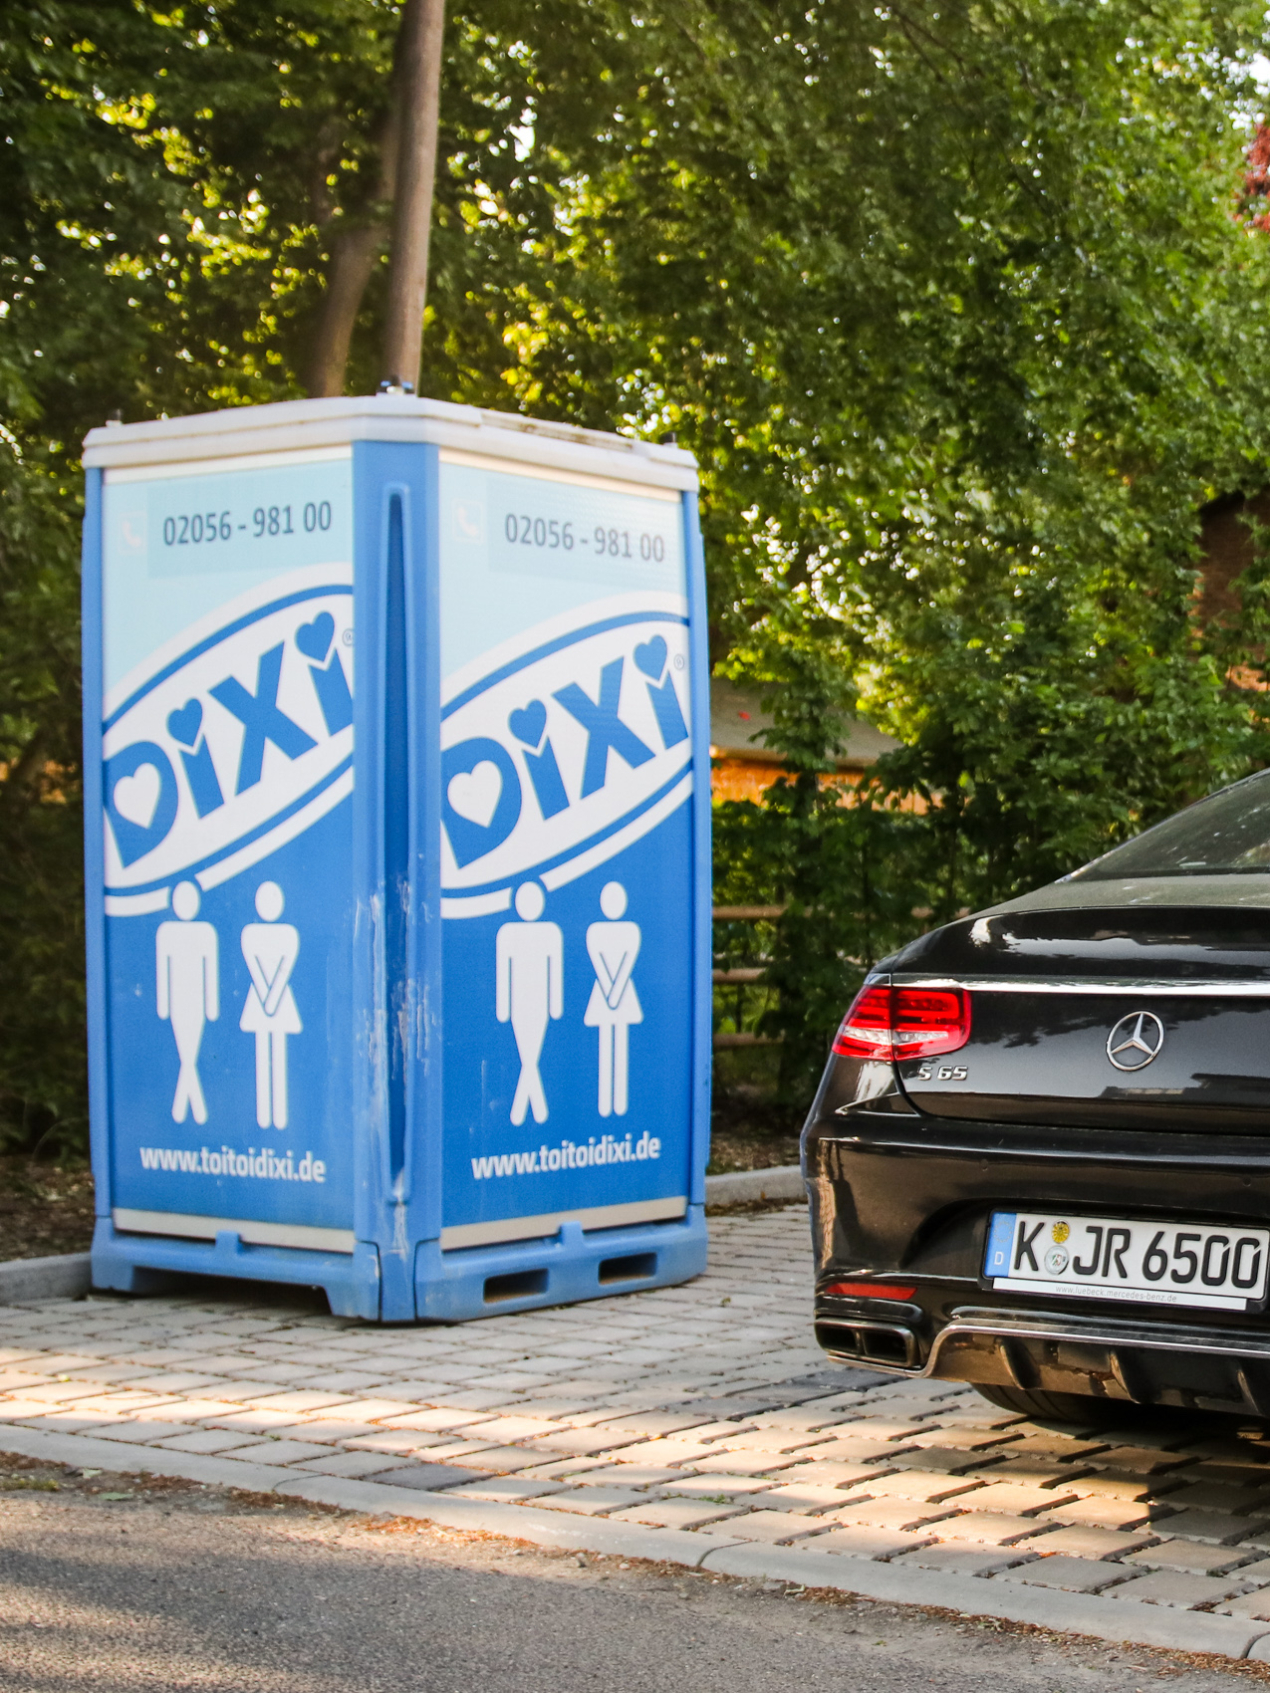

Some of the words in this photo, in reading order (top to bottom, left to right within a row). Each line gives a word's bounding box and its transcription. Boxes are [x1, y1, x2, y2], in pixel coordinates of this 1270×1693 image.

[303, 501, 332, 533] 00
[640, 533, 665, 562] 00
[918, 1066, 932, 1081] S
[937, 1066, 968, 1081] 65
[139, 1144, 327, 1184] www.toitoidixi.de
[471, 1130, 662, 1180] www.toitoidixi.de
[994, 1251, 1005, 1266] D
[1013, 1220, 1045, 1272] K
[1072, 1225, 1131, 1279] JR
[1141, 1231, 1261, 1289] 6500
[1055, 1285, 1178, 1303] www.luebeck.mercedes-benz.de
